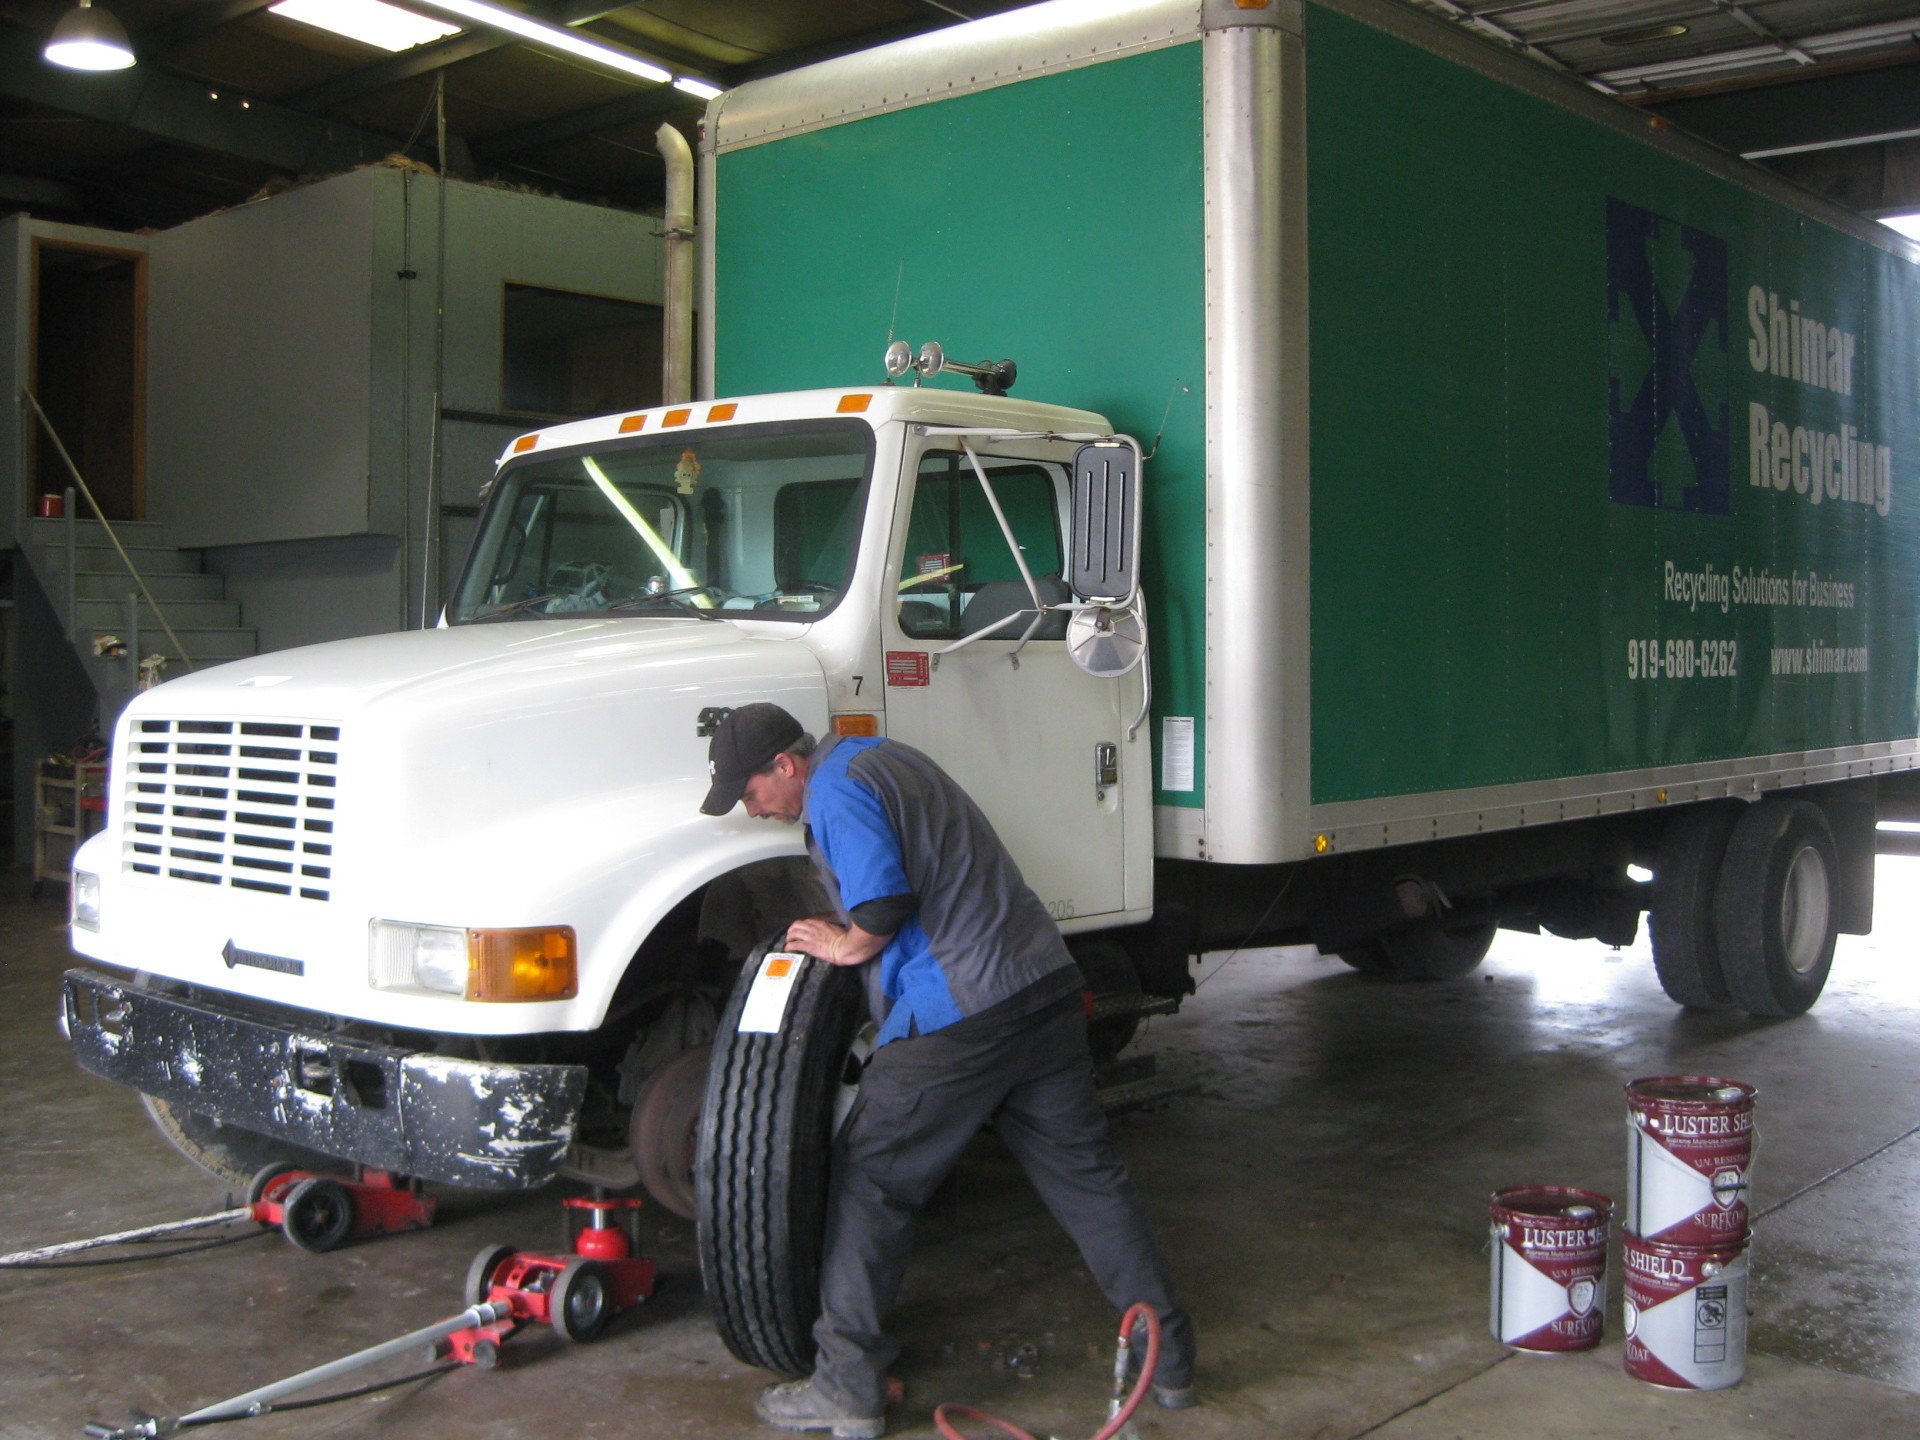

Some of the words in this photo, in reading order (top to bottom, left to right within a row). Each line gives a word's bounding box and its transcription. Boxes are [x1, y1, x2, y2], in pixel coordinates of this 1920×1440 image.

[1748, 285, 1855, 396] Shimar
[1750, 401, 1890, 517] Recycling
[1664, 560, 1729, 613] Recycling
[1732, 565, 1789, 606] Solutions
[1792, 570, 1809, 606] for
[1809, 571, 1854, 609] Business
[1628, 639, 1737, 680] 919-680-6262
[1771, 640, 1868, 675] www.shimar.com
[852, 676, 864, 696] 7
[1663, 1114, 1730, 1135] LUSTER
[1523, 1228, 1587, 1248] LUSTER
[1630, 1249, 1686, 1278] SHIELD
